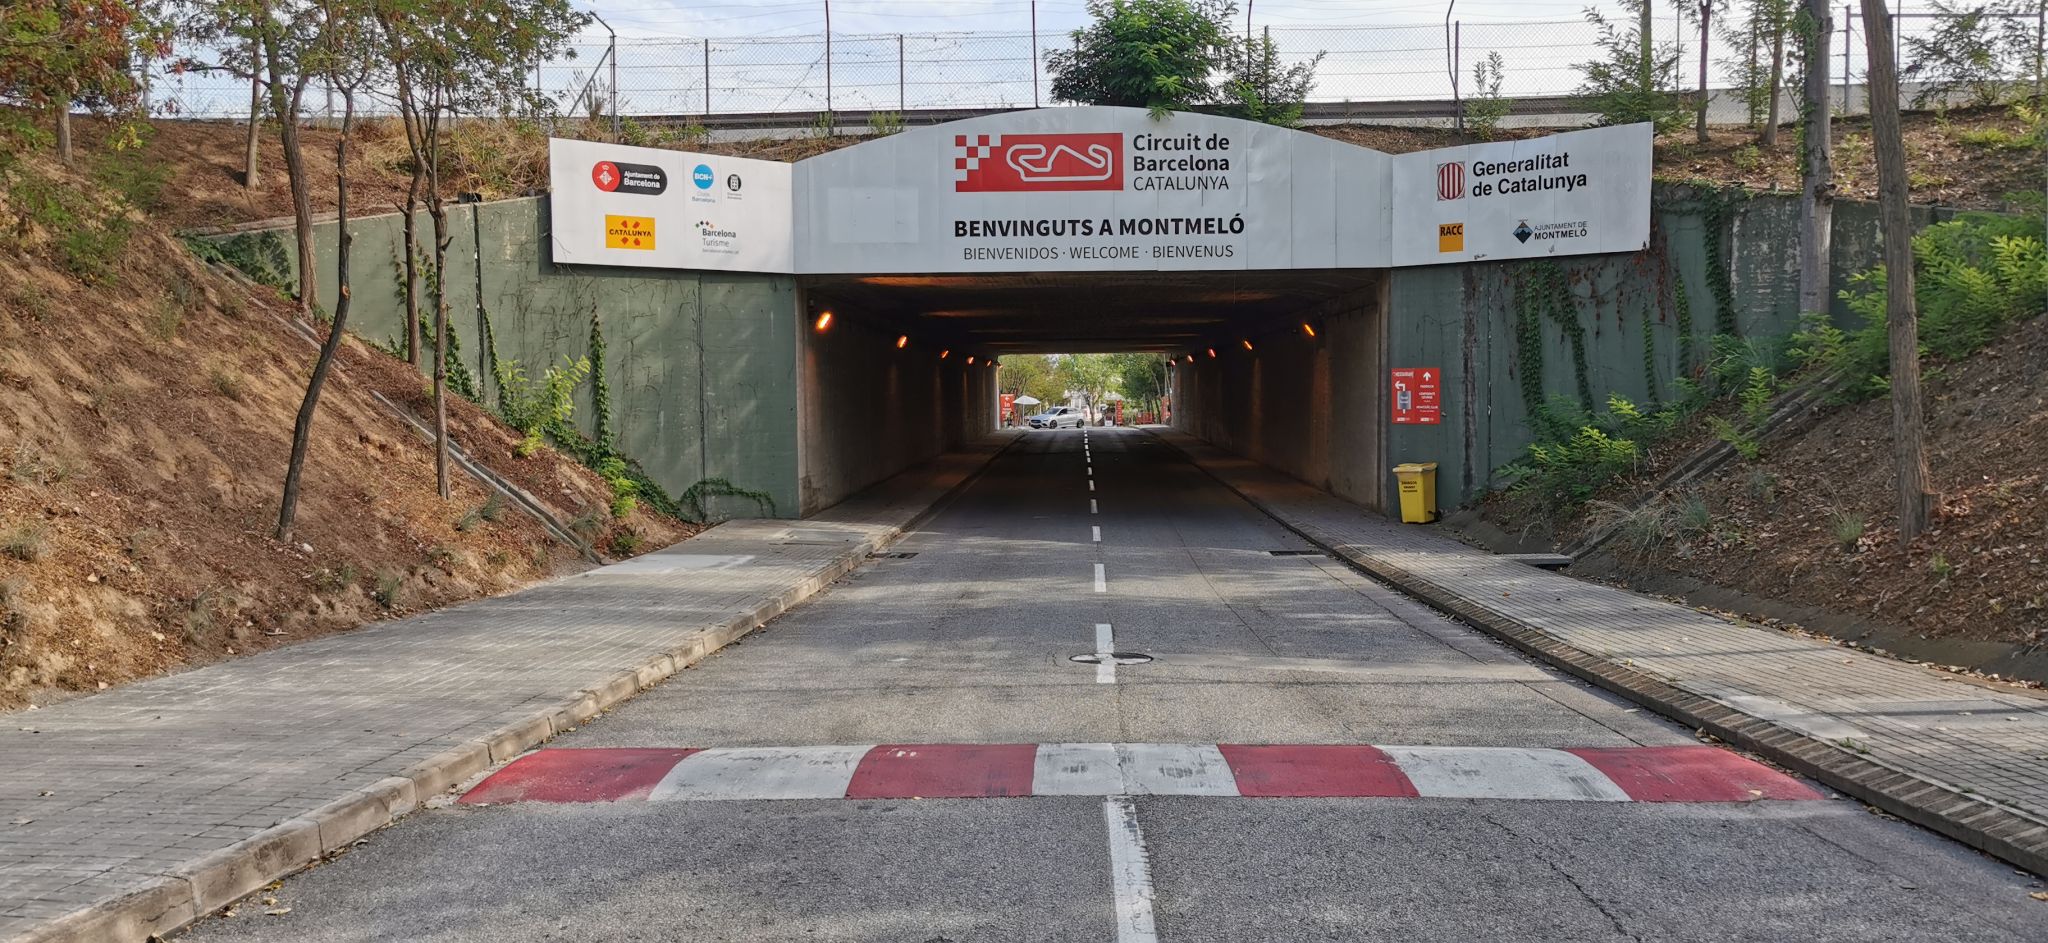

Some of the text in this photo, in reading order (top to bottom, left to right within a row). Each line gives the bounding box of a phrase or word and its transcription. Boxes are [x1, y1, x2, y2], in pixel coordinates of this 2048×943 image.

[1134, 134, 1229, 151] Circuit de
[1134, 155, 1230, 171] Barcelona
[1473, 152, 1569, 177] Generalitat
[624, 170, 653, 179] Ajuntament
[624, 178, 660, 188] Barcelona
[1134, 176, 1229, 191] CATALUNYA
[1473, 173, 1586, 197] de Catalunya
[954, 213, 1245, 238] BENVINGUTS A MONTMELÓ
[1440, 225, 1463, 236] RACC
[1534, 222, 1576, 231] AJUNTAMENT
[609, 228, 652, 237] CATALUNYA
[703, 229, 736, 238] Barcelona
[1534, 229, 1587, 240] MONTMELÓ
[703, 239, 730, 247] Turisme
[964, 245, 1233, 260] BIENVENIDOS WELCOME BIENVENUS
